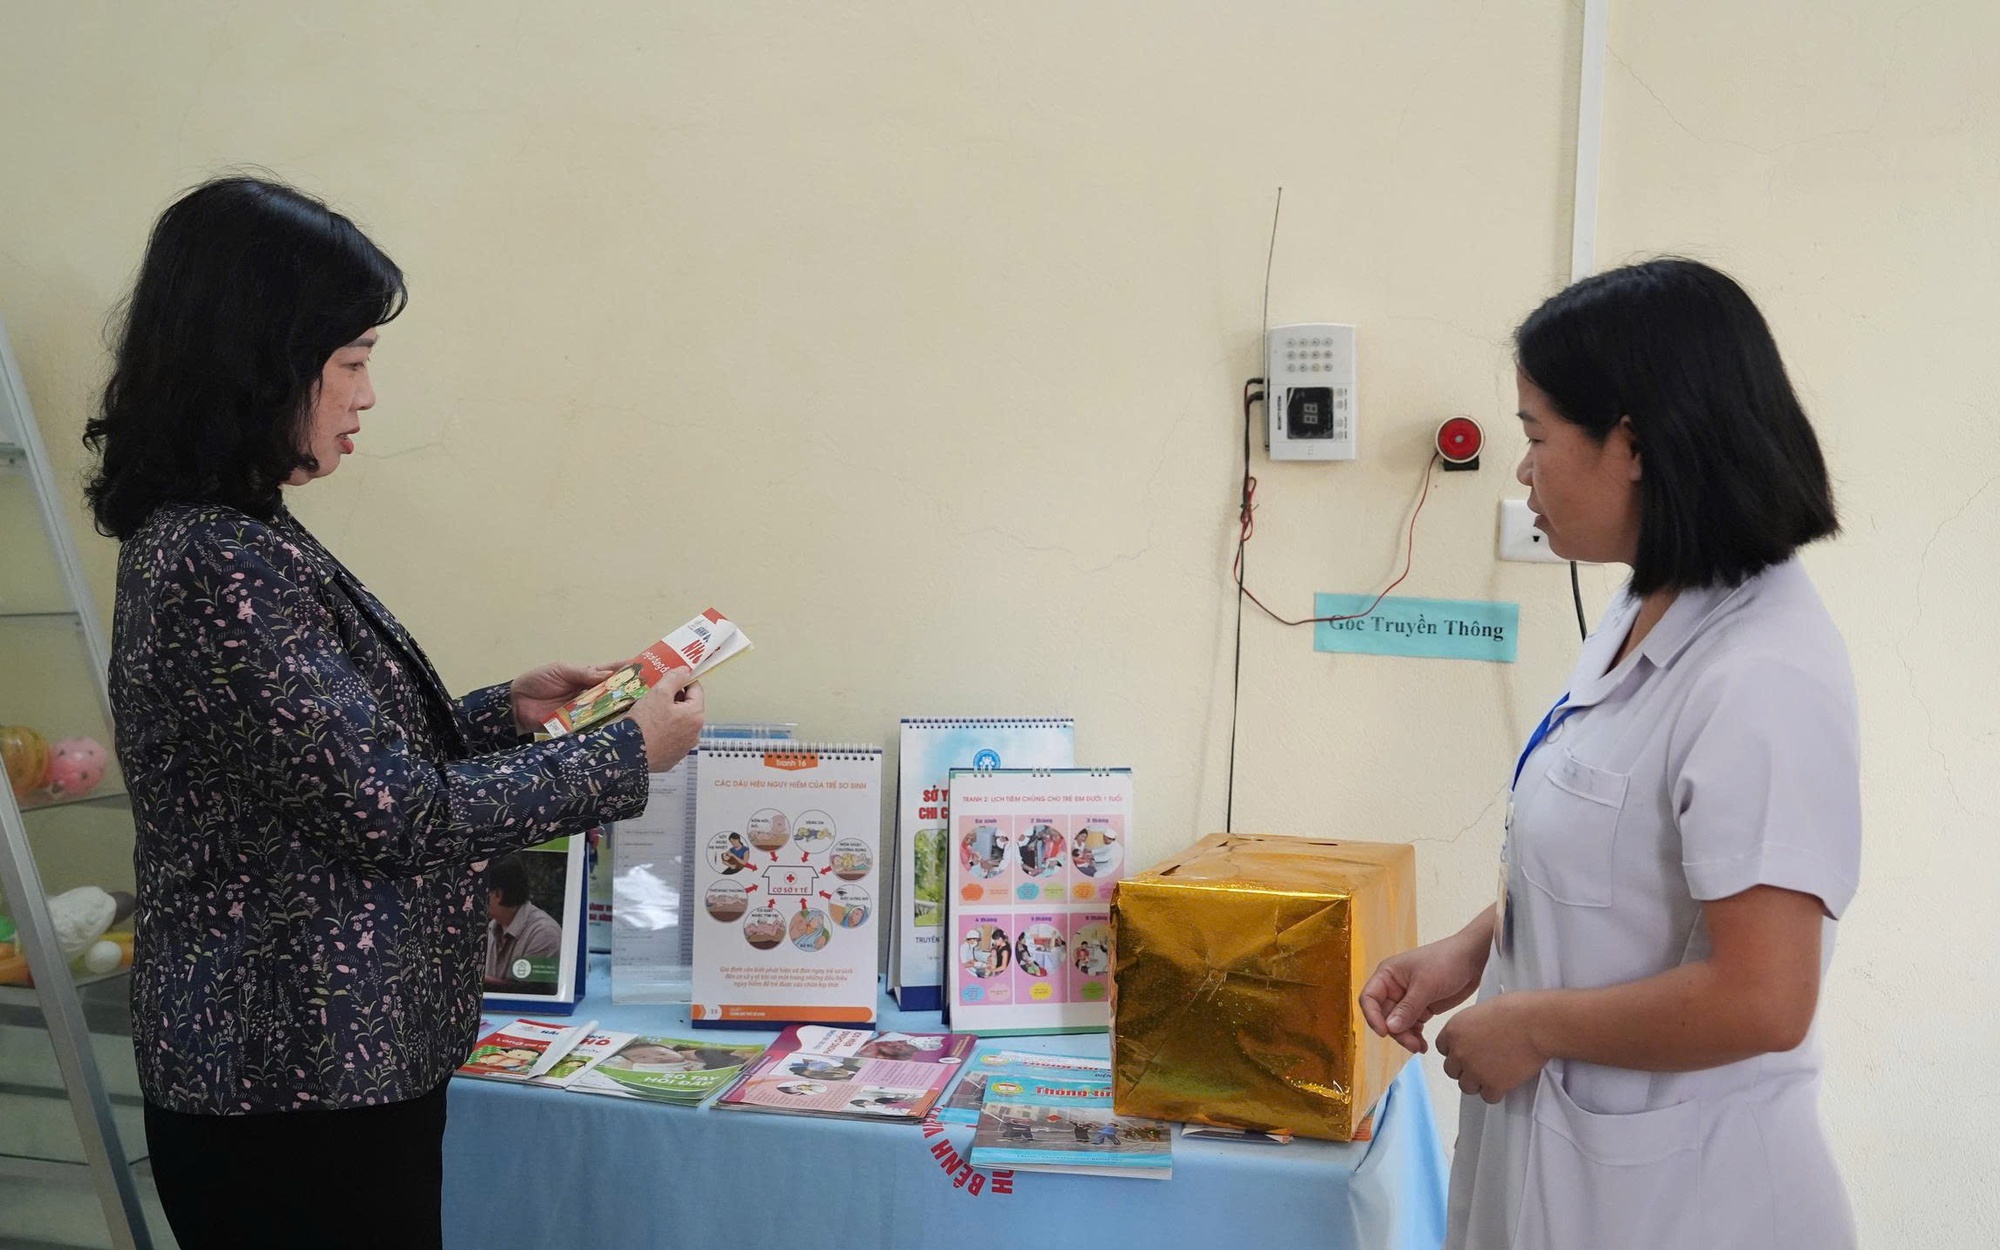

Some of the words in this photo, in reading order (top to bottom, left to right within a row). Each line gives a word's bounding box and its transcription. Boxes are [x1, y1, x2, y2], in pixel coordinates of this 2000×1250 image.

[1371, 613, 1437, 637] Truyền
[1443, 620, 1504, 641] Thông
[923, 785, 939, 802] SỞ
[919, 807, 938, 820] CHI
[1036, 1085, 1087, 1097] Thông
